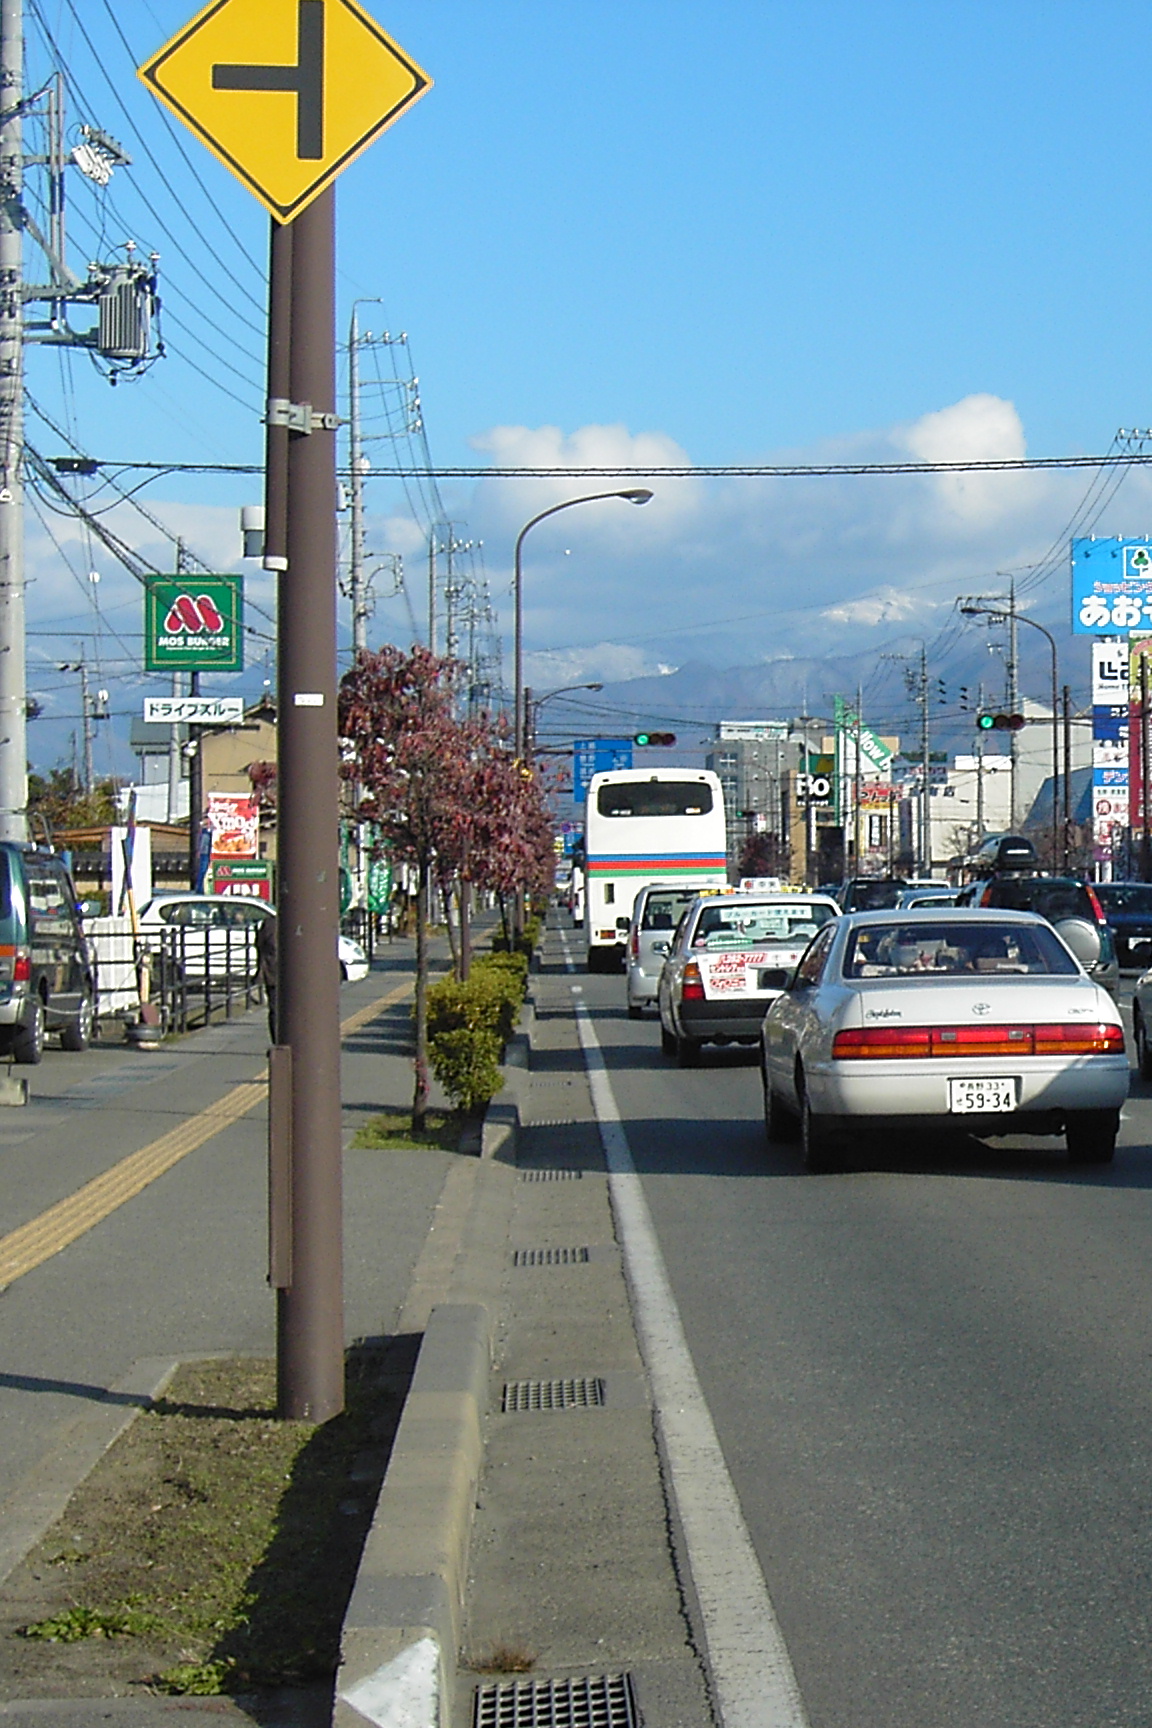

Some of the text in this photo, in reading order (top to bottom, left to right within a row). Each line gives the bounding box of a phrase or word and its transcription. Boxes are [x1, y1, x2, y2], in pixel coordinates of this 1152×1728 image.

[158, 636, 230, 647] MOS BURGER
[965, 1092, 1010, 1109] 59-34
